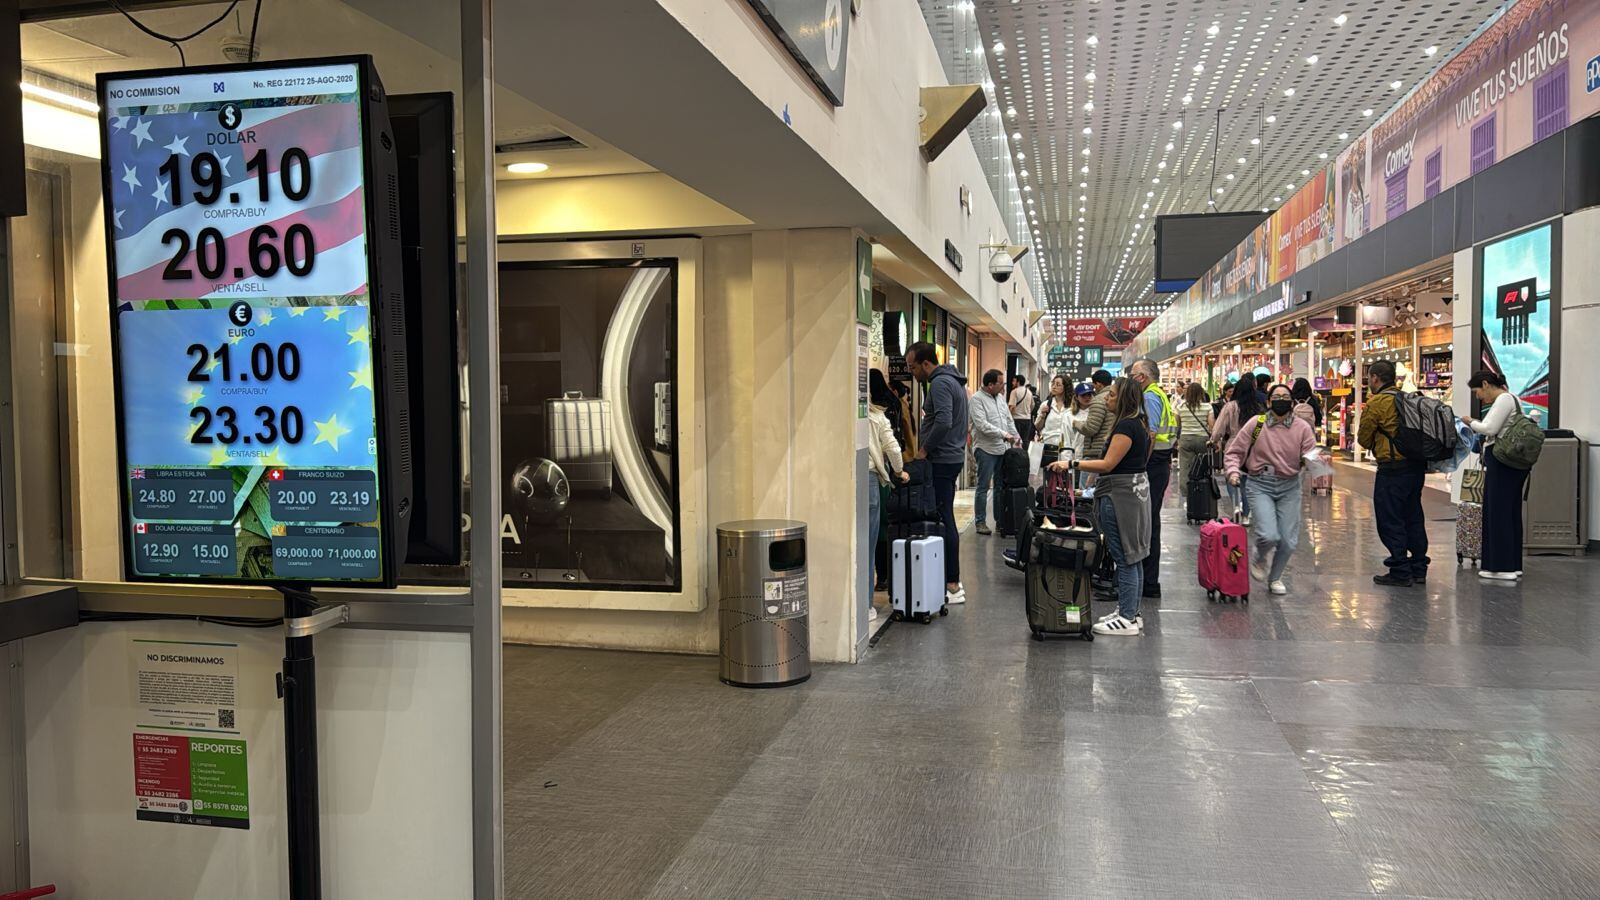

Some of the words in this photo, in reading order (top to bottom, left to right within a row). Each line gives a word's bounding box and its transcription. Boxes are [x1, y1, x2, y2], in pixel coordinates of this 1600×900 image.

[267, 80, 283, 88] REG
[284, 78, 306, 87] 22172
[307, 74, 354, 85] 25-AGO-2020
[1455, 88, 1480, 128] VIVE
[1482, 69, 1506, 110] TUS
[1509, 23, 1569, 93] SUEÑOS
[110, 90, 124, 99] NO
[126, 86, 180, 98] COMMISION
[207, 130, 257, 146] DOLAR
[1385, 127, 1418, 178] Comex
[158, 147, 312, 206] 19.10
[203, 207, 268, 219] COMPRA/BUY
[161, 223, 316, 281] 20.60
[211, 283, 268, 293] VENTA/SELL
[228, 328, 256, 338] EURO
[186, 342, 301, 382] 21.00
[220, 387, 269, 396] COMPRA/BUY
[189, 405, 304, 445] 23.30
[225, 450, 269, 458] VENTA/SELL
[139, 489, 176, 503] 24.80
[188, 489, 226, 503] 27.00
[277, 490, 317, 505] 20.00
[329, 491, 370, 505] 23.19
[142, 543, 179, 557] 12.90
[192, 544, 229, 558] 15.00
[275, 547, 324, 559] 69,000.00
[327, 548, 377, 560] 71,000.00
[146, 653, 159, 661] NO
[160, 654, 225, 665] DISCRIMINAMOS
[191, 742, 243, 755] REPORTES
[230, 804, 248, 813] 0209
